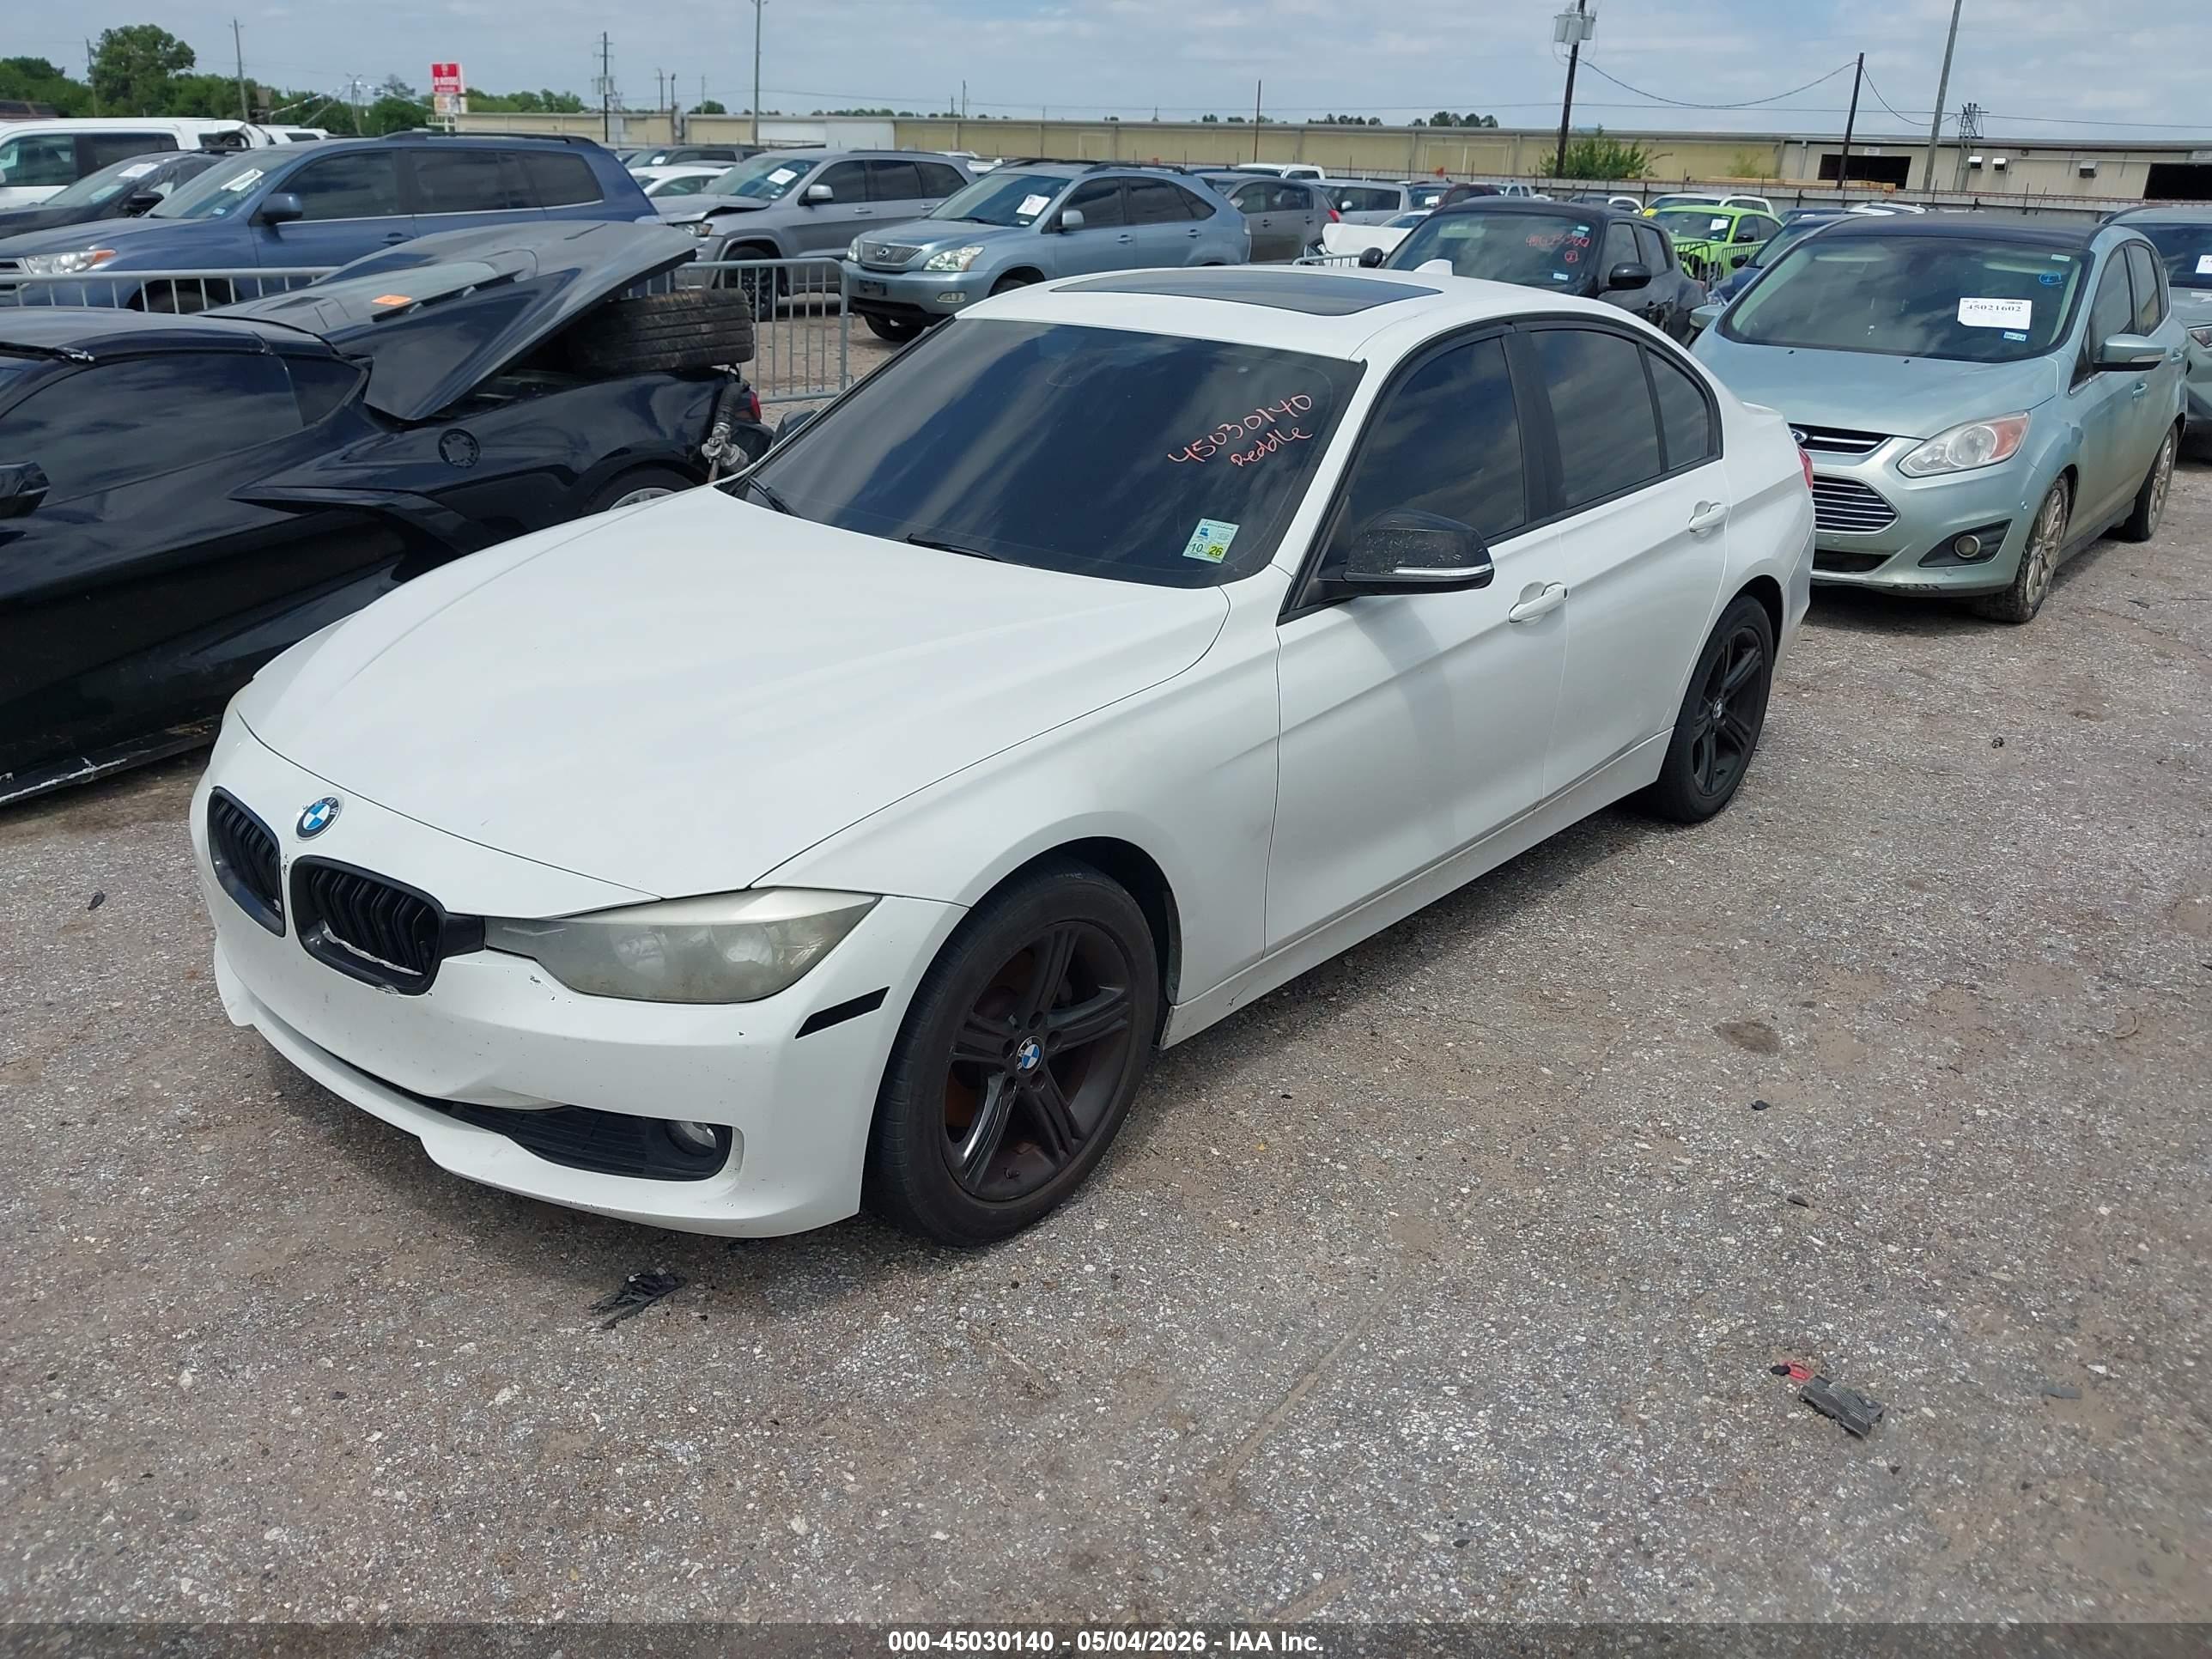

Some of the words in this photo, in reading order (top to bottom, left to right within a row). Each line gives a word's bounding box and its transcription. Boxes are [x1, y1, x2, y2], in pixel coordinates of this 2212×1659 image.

[1167, 394, 1312, 463] 45030140
[1191, 543, 1204, 553] 10
[1209, 545, 1224, 556] 26
